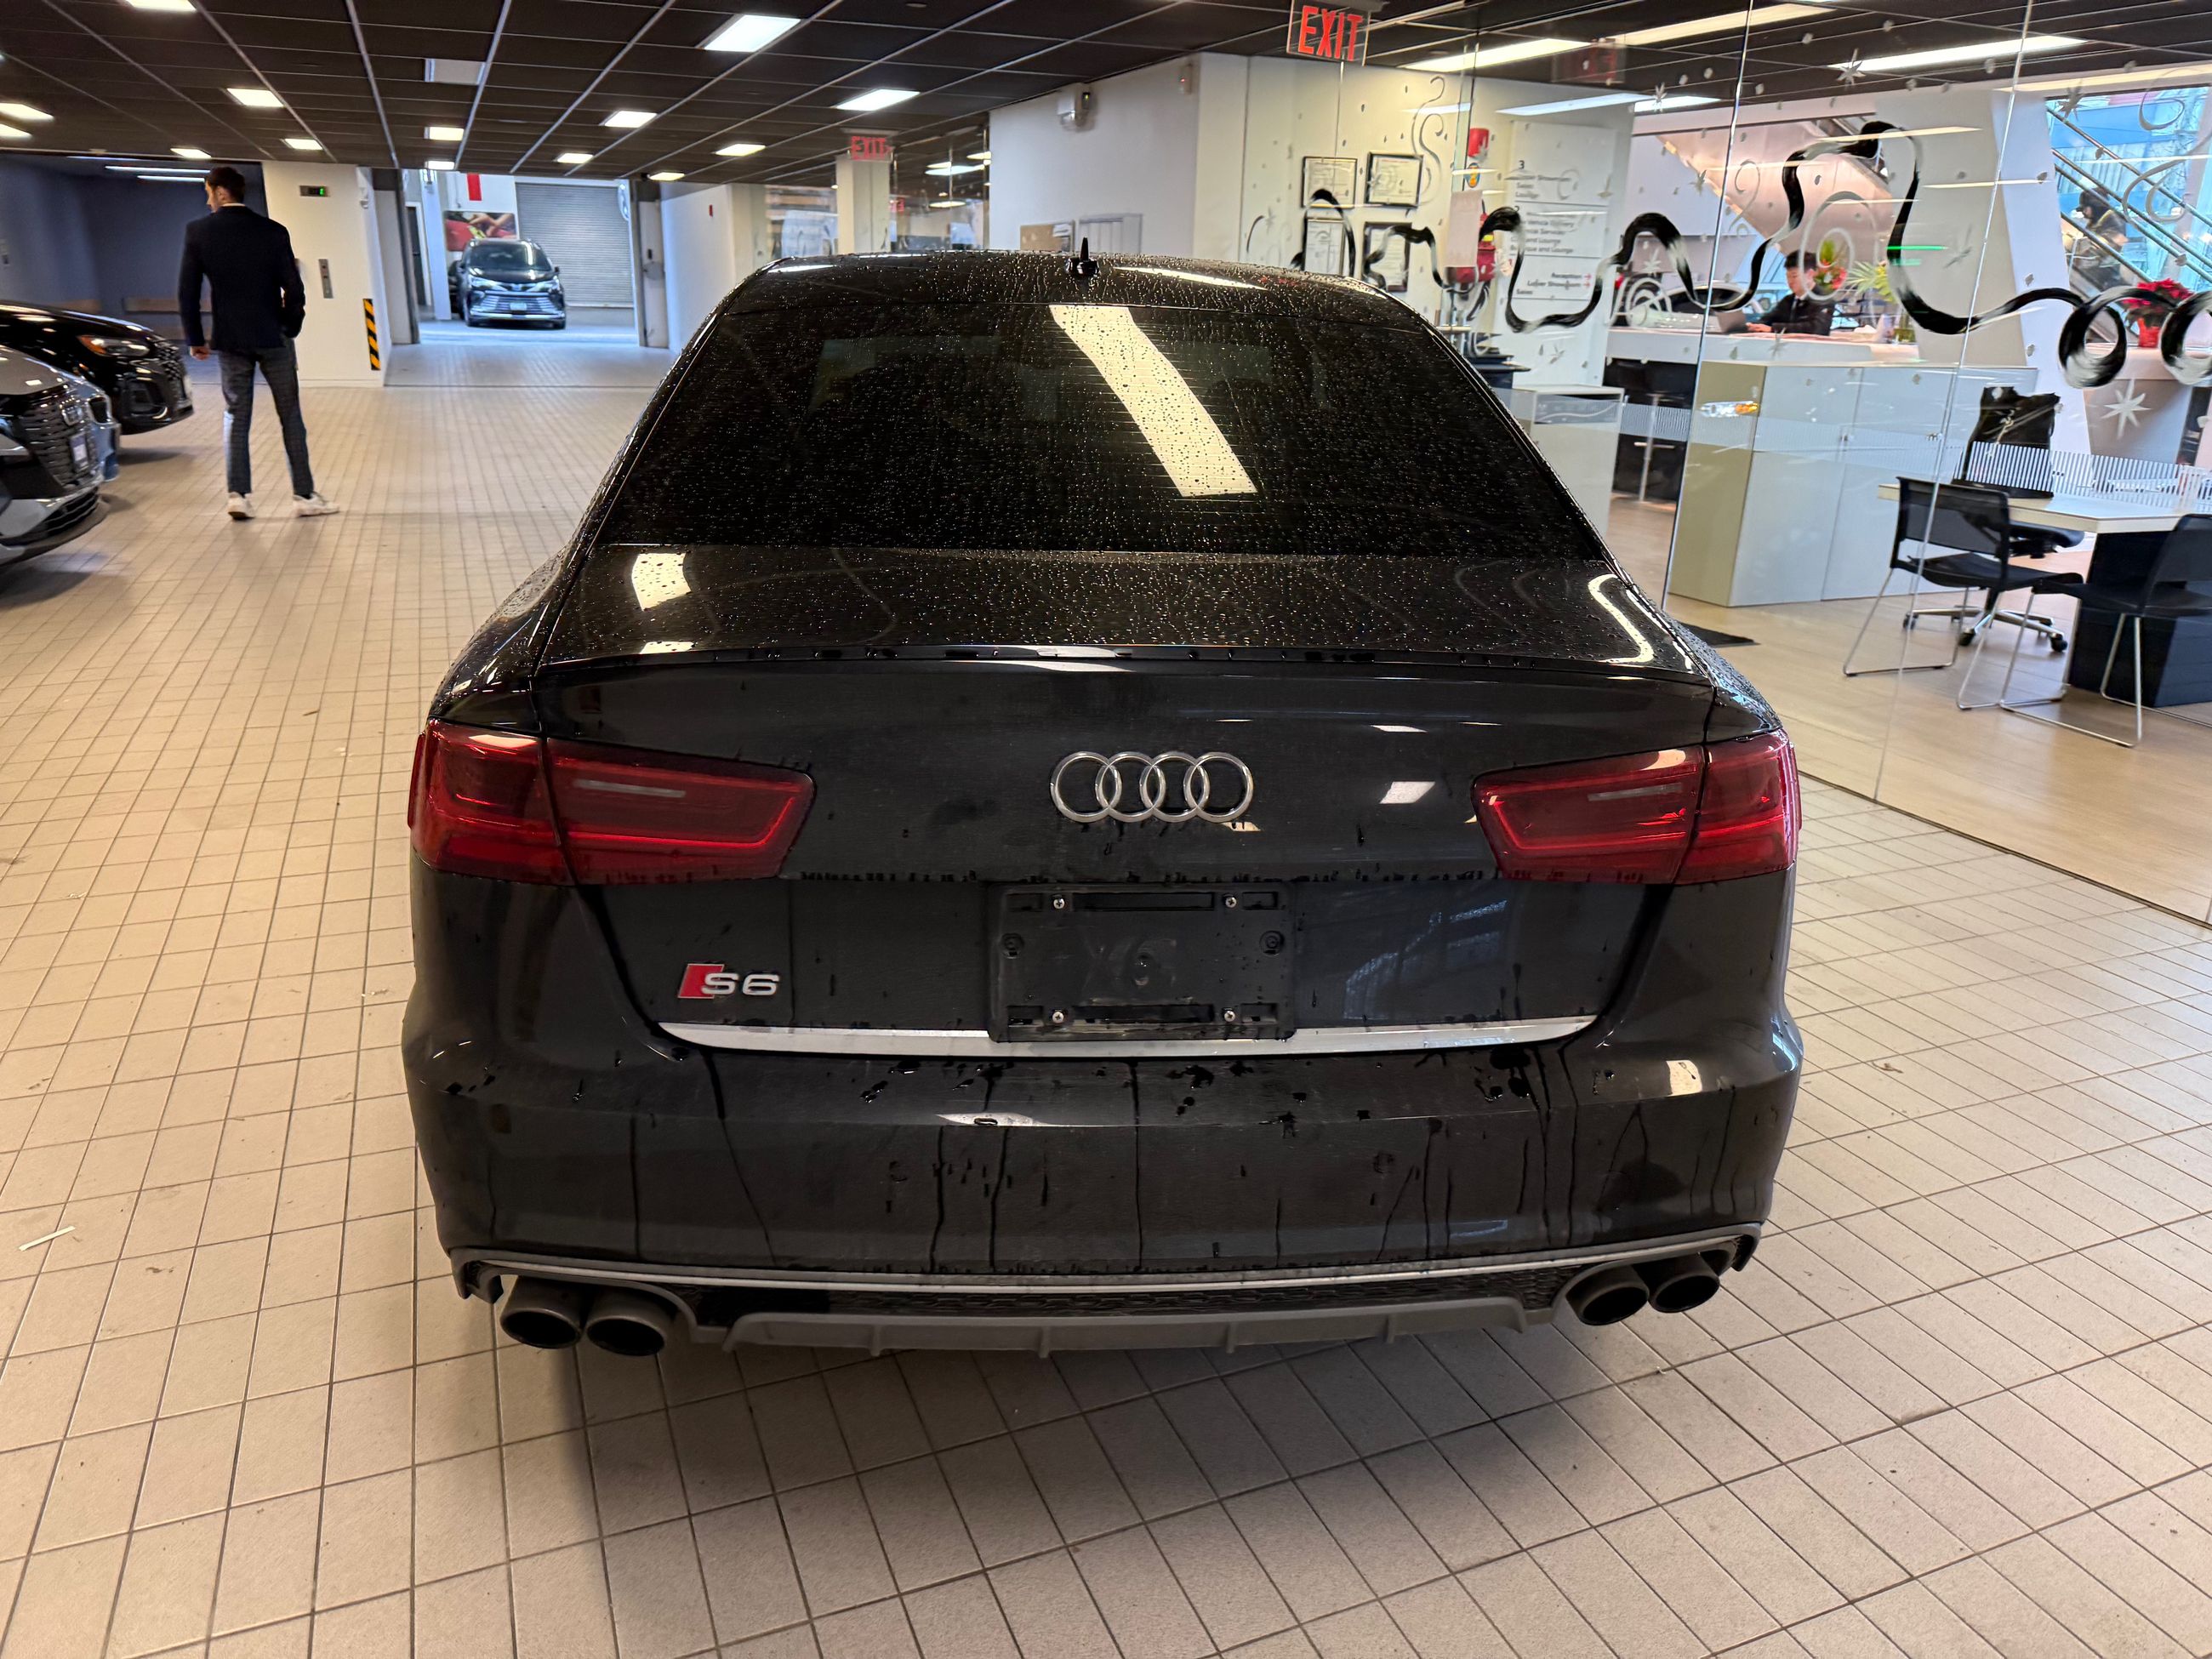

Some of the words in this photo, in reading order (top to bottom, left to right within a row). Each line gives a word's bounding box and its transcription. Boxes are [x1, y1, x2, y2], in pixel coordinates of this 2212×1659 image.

[1298, 5, 1364, 61] EXIT
[852, 136, 887, 161] EXIT
[1519, 160, 1525, 169] 3
[701, 972, 780, 996] S6
